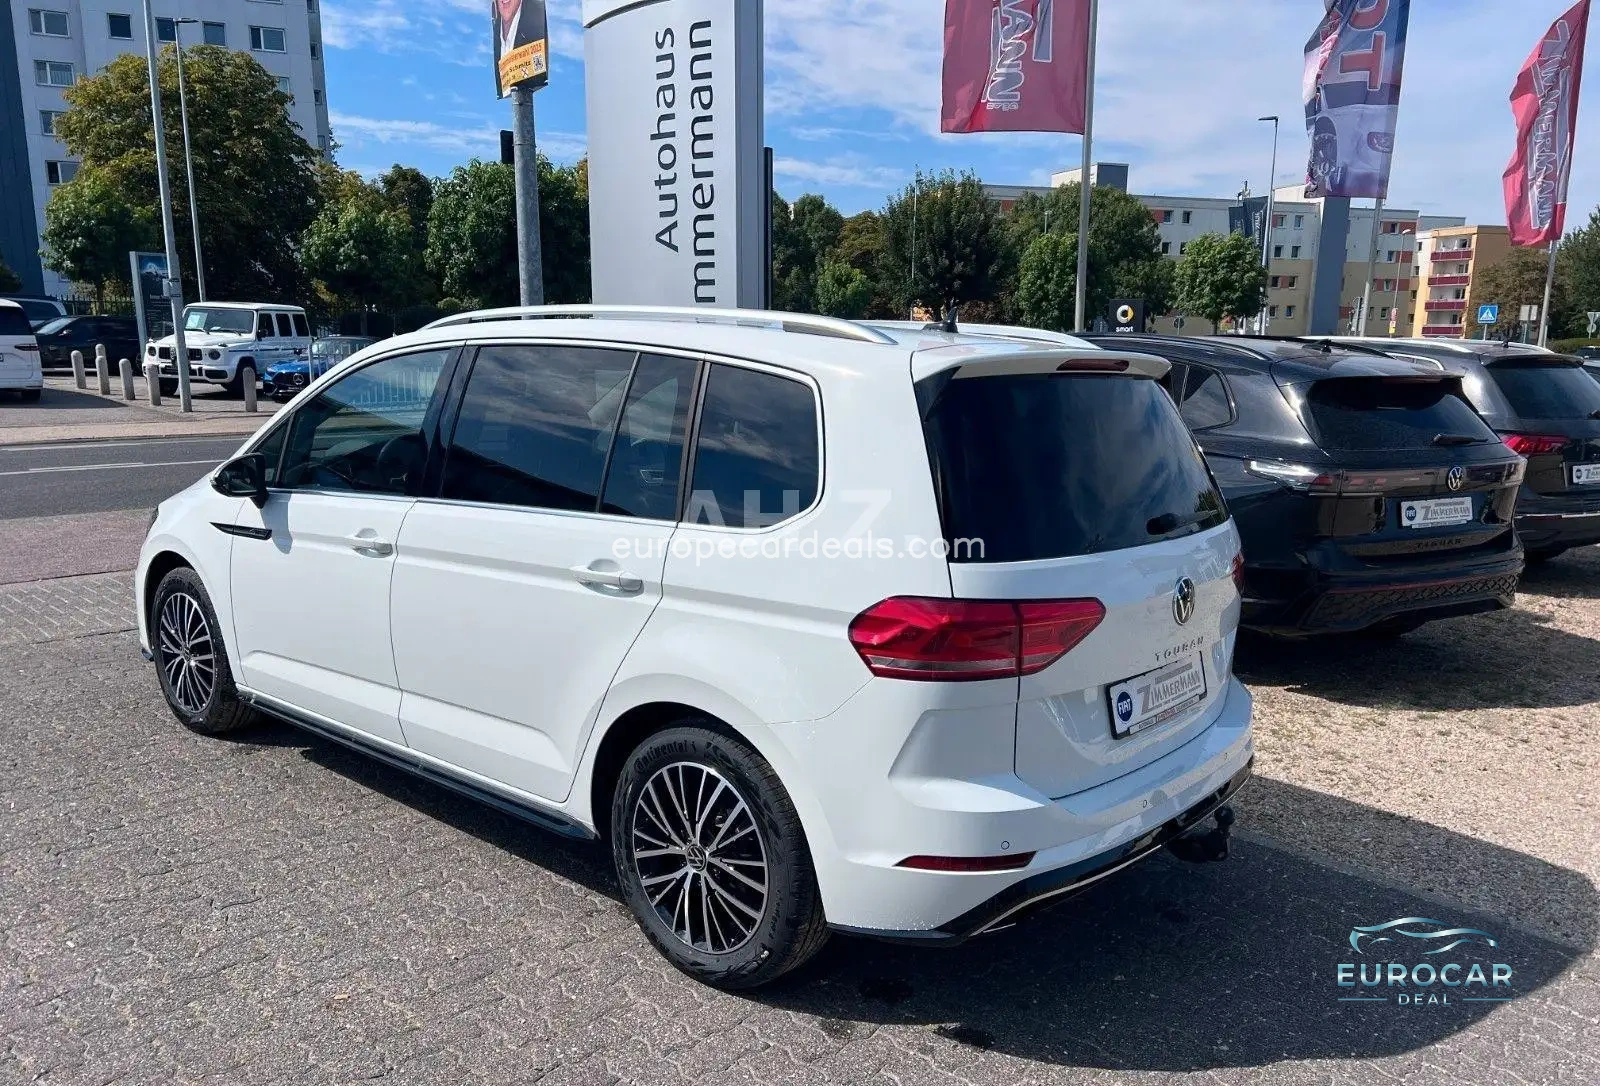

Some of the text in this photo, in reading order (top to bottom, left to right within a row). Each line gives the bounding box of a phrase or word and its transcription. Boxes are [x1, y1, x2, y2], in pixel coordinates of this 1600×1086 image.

[650, 27, 679, 254] Autohaus
[1154, 636, 1204, 662] TOURAN
[634, 740, 688, 773] Continental
